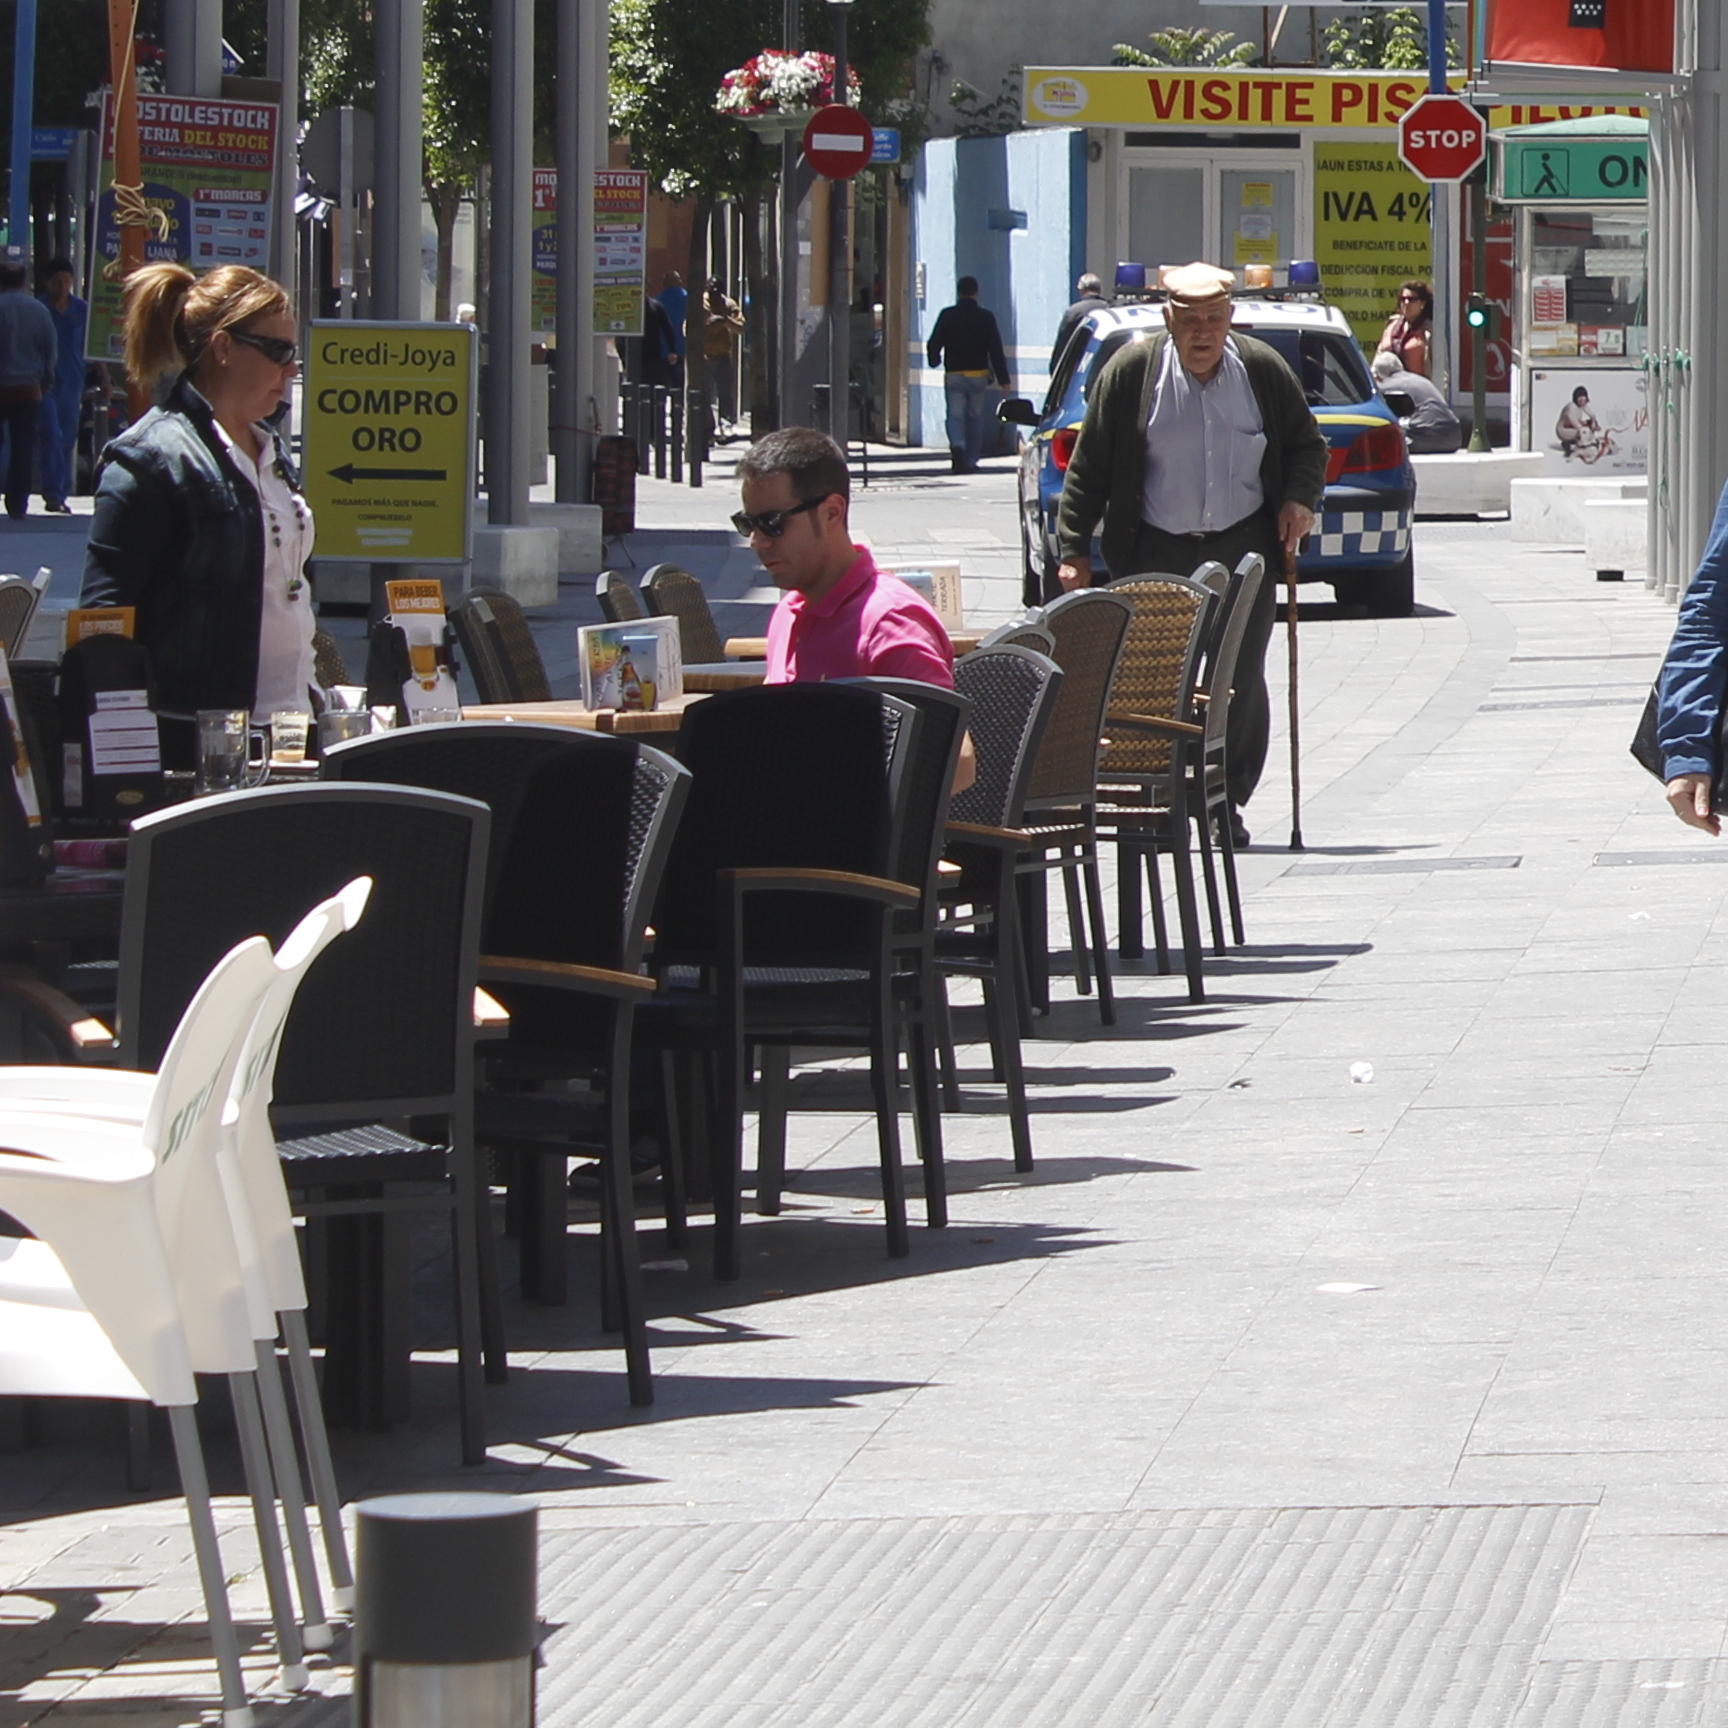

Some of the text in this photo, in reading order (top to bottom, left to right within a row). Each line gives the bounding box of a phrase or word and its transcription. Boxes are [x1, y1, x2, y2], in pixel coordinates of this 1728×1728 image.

[1147, 78, 1316, 123] VISITE
[1330, 80, 1456, 124] PIS
[112, 101, 270, 130] STOLESTOCK
[184, 129, 215, 146] DEL
[217, 132, 269, 150] STOCK
[1409, 129, 1477, 150] STOP
[1349, 160, 1385, 173] ESTAS
[1386, 161, 1395, 172] A
[1322, 191, 1378, 222] IVA
[1332, 240, 1428, 252] BENEFICIATE DE LA
[1381, 265, 1417, 276] FISCAL
[1419, 265, 1432, 276] PO
[1324, 287, 1369, 298] COMPRA
[1371, 288, 1386, 299] DE
[1347, 310, 1396, 321] OLO HAS
[321, 341, 456, 373] Credi-Joya
[317, 388, 459, 417] COMPRO
[351, 426, 423, 453] ORO
